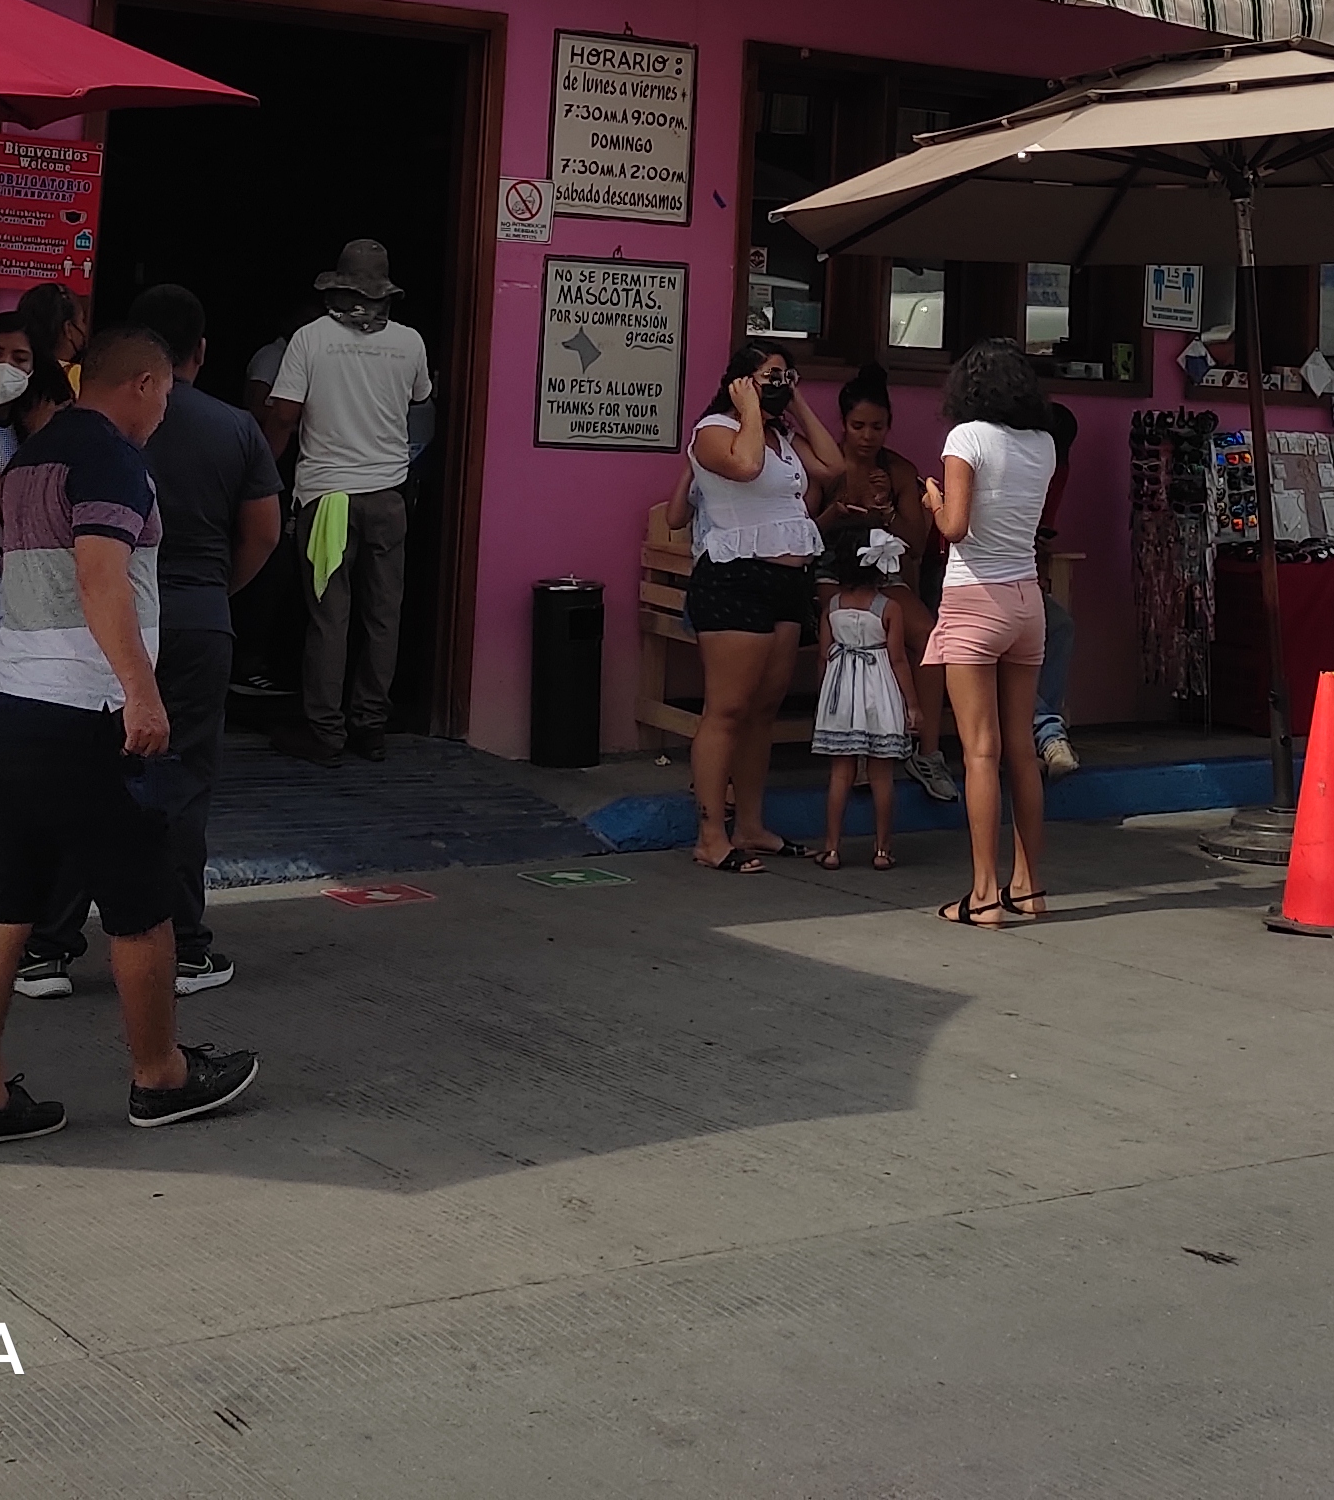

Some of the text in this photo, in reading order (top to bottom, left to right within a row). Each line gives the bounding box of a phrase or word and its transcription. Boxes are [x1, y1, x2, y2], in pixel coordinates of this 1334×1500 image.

[563, 70, 678, 101] de lunes a viernes
[4, 141, 88, 162] Bienvenidos
[591, 132, 653, 153] DOMINGO
[19, 156, 71, 172] Welcome
[13, 187, 75, 203] MANDATORY
[603, 185, 683, 211] descansamos
[554, 268, 677, 290] NO SE PERMITEN
[557, 285, 662, 310] MASCOTAS.
[549, 308, 572, 323] POR
[574, 311, 590, 324] SU
[548, 377, 663, 398] NO PETS ALLOWED
[547, 400, 658, 417] THANKS FOR YOUR
[570, 421, 660, 436] UNDERSTANDING
